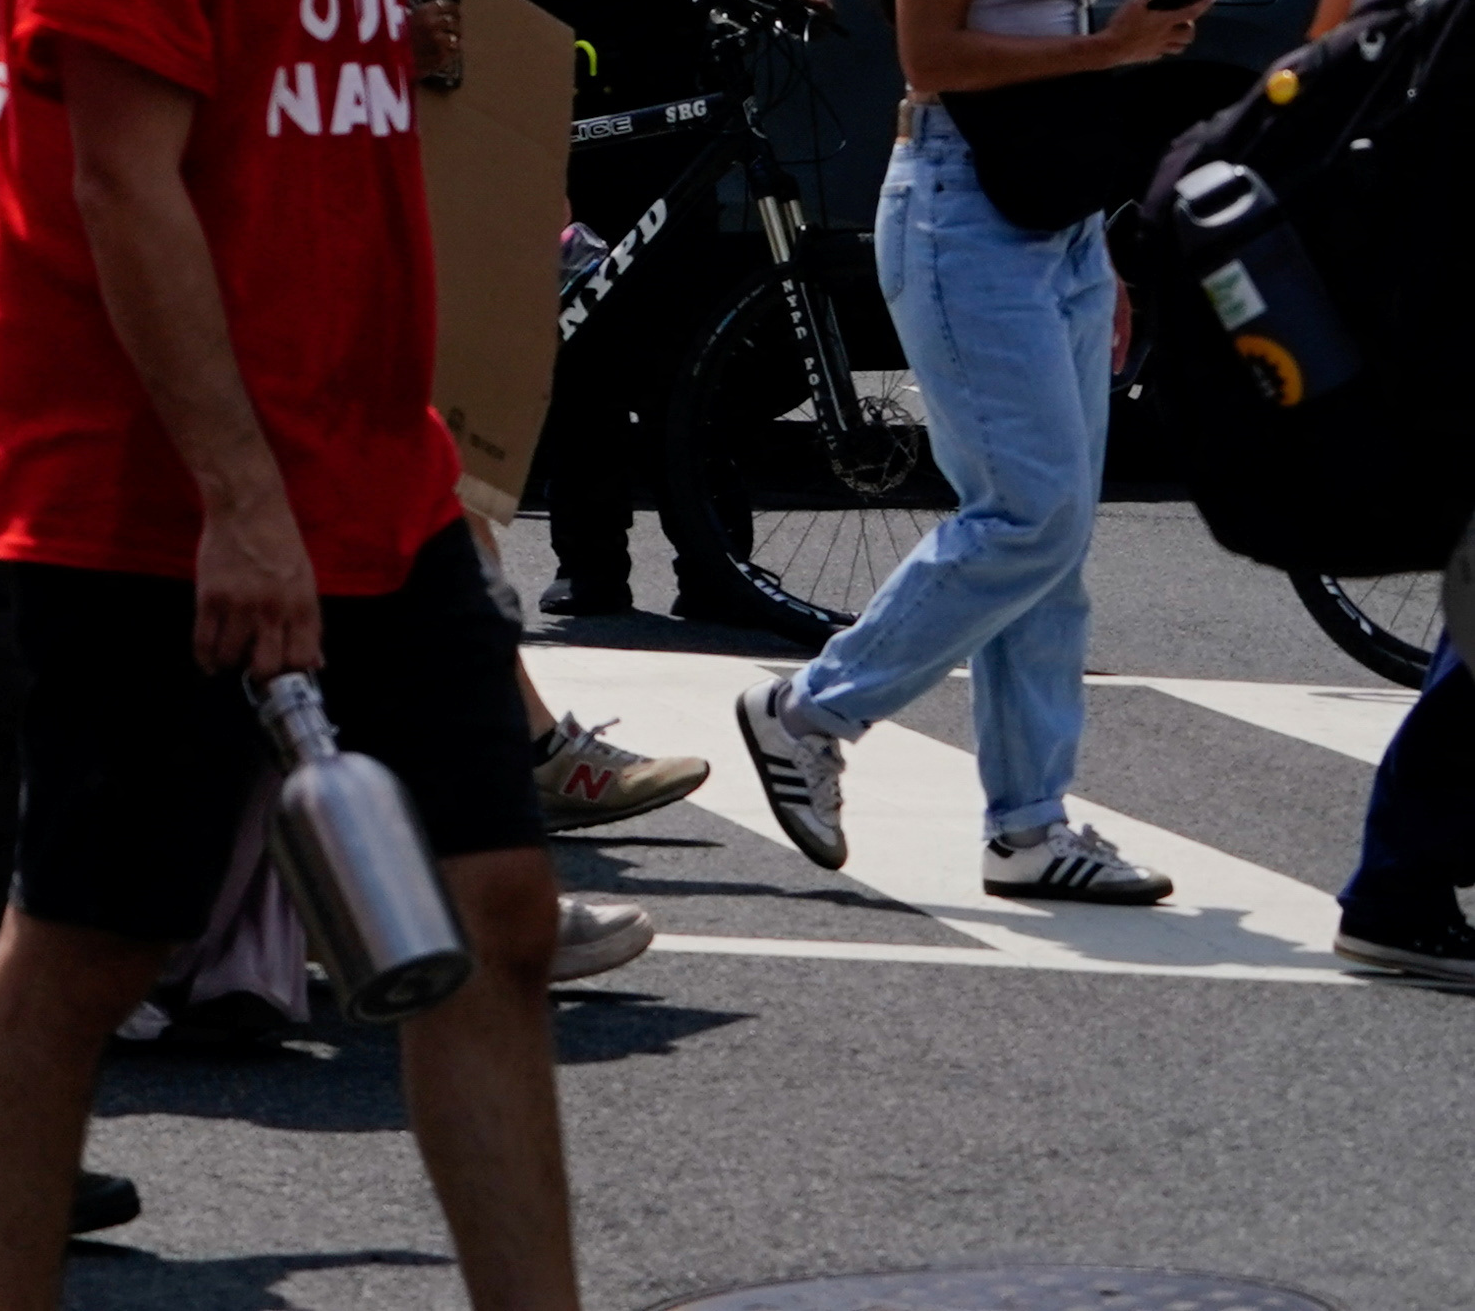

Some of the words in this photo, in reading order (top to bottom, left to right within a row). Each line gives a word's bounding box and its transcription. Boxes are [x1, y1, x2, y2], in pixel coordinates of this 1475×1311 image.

[571, 115, 634, 143] ICE
[666, 98, 708, 123] SRG
[558, 197, 668, 342] NYPD
